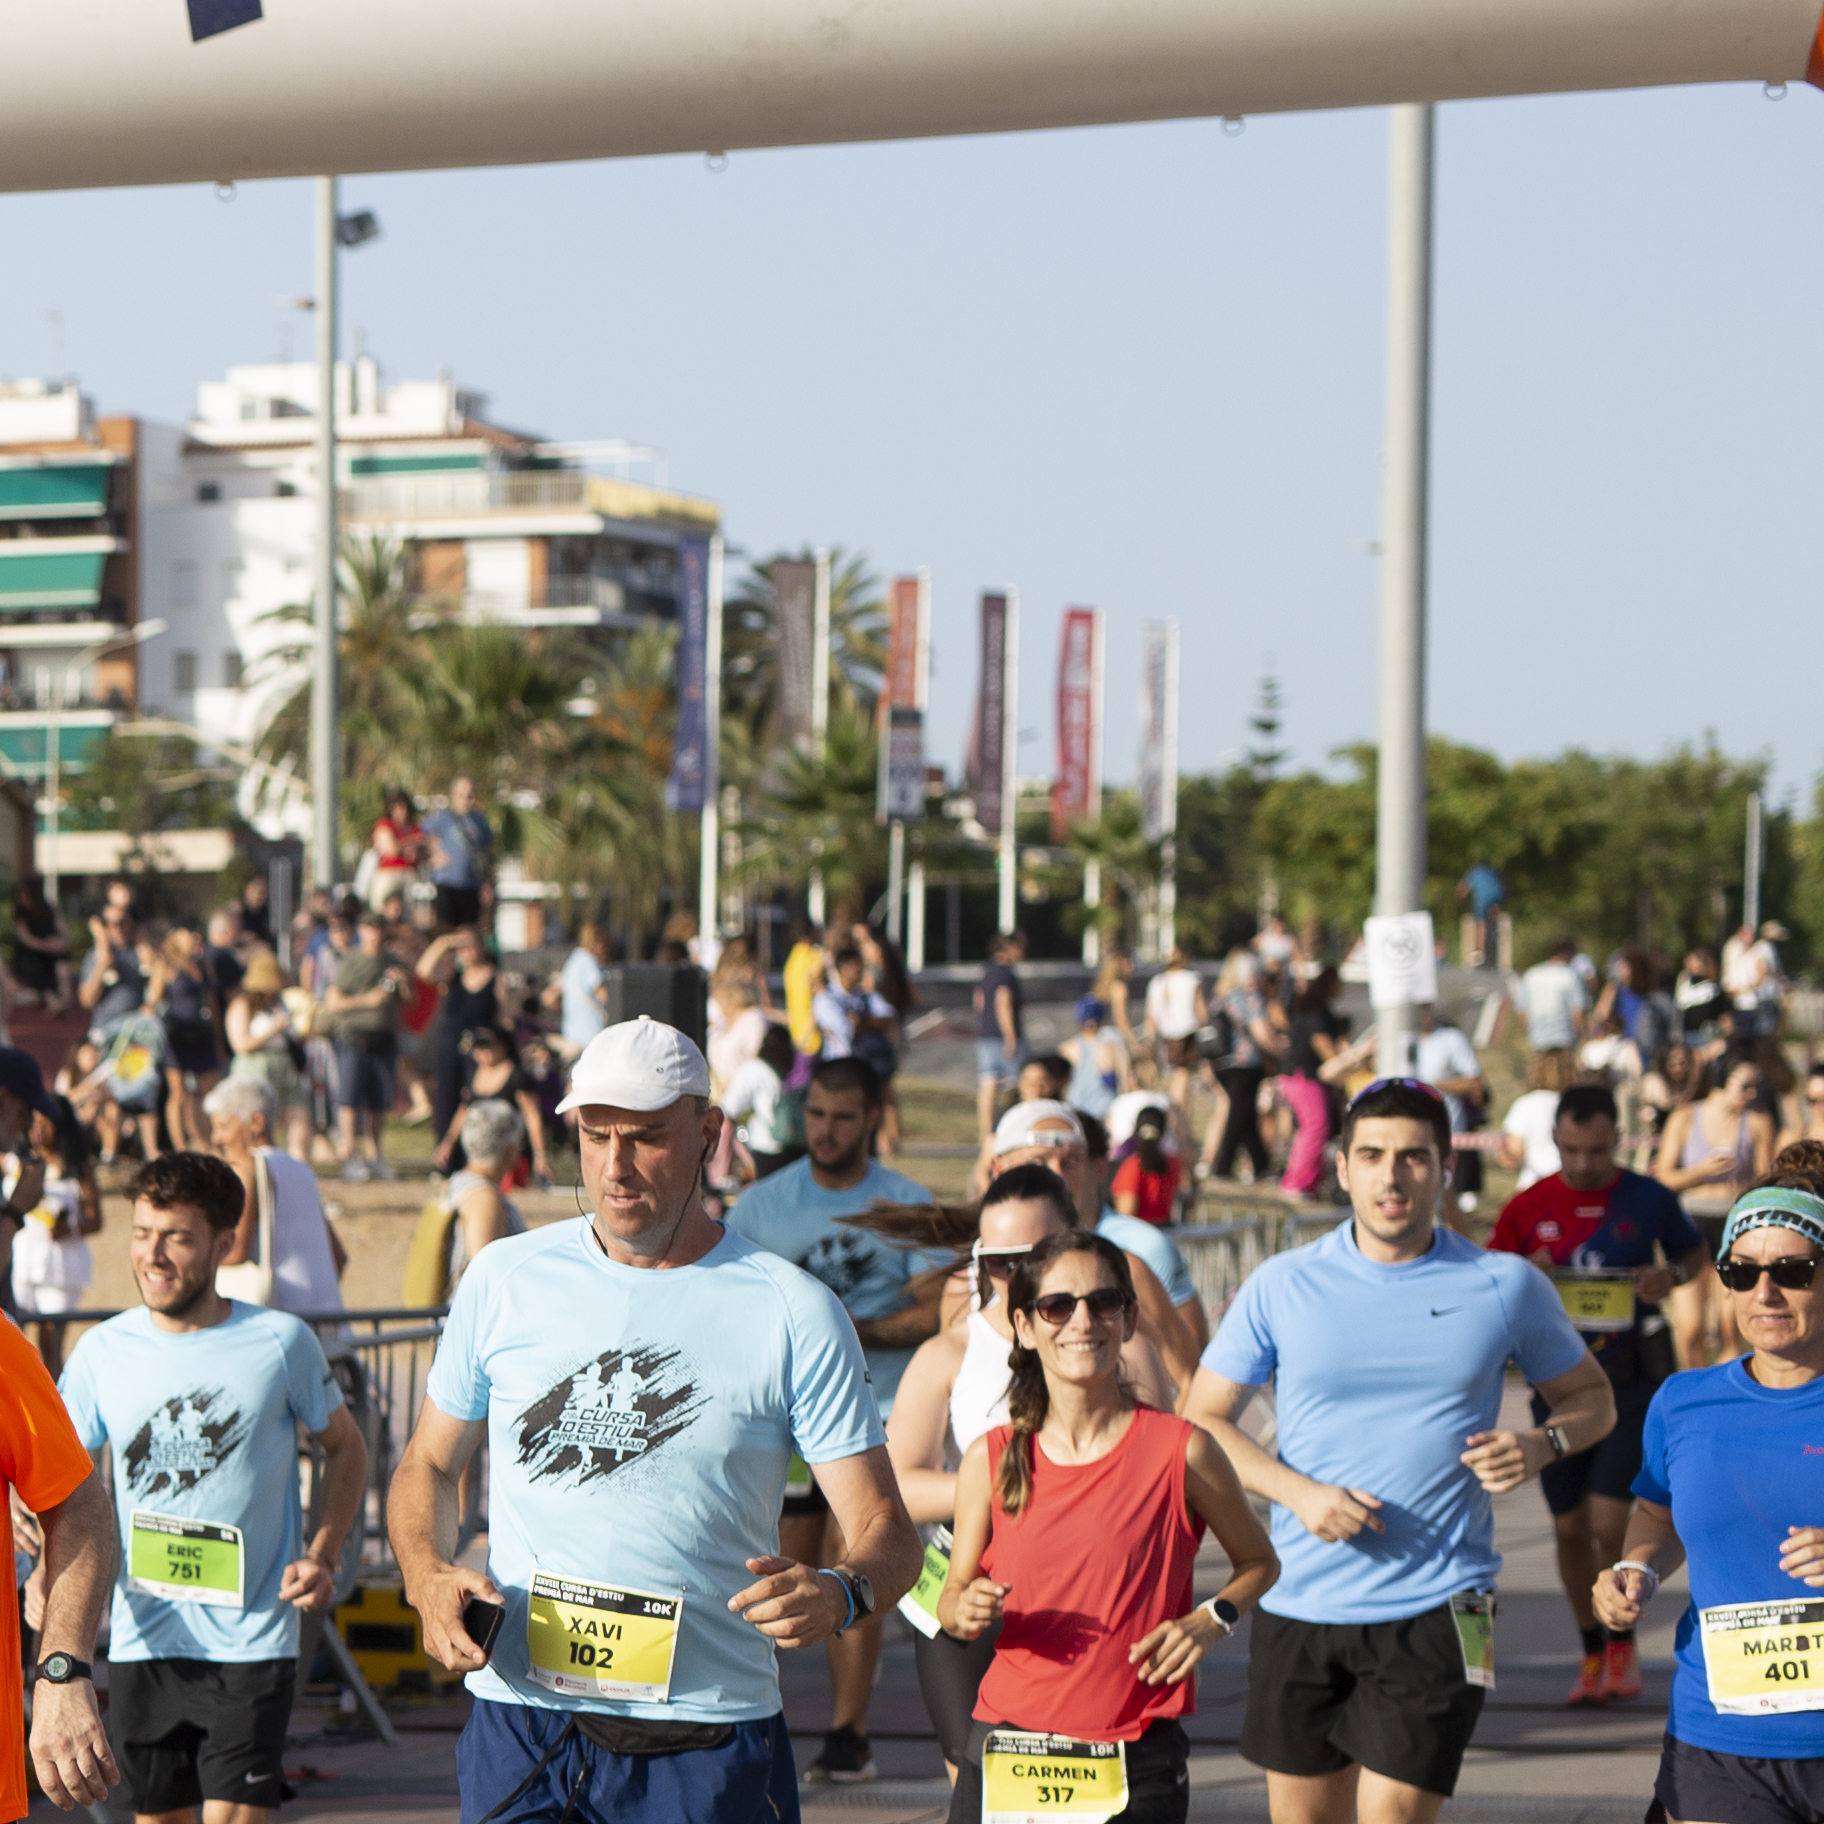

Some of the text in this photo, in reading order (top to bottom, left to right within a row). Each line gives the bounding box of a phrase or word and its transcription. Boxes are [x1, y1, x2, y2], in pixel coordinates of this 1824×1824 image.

[580, 1408, 645, 1429] CURSA
[615, 1438, 645, 1450] MAR
[167, 1543, 203, 1559] ERIC
[168, 1561, 202, 1580] 751
[560, 1582, 588, 1596] CURSA
[589, 1588, 625, 1602] D'ESTIU
[562, 1591, 574, 1602] DE
[574, 1595, 595, 1606] MAR
[643, 1601, 673, 1616] 10K
[568, 1616, 623, 1641] XAVI
[569, 1641, 614, 1670] 102
[1765, 1660, 1809, 1682] 401
[1090, 1743, 1115, 1756] 10K
[1011, 1763, 1098, 1780] CARMEN
[1036, 1785, 1075, 1804] 317
